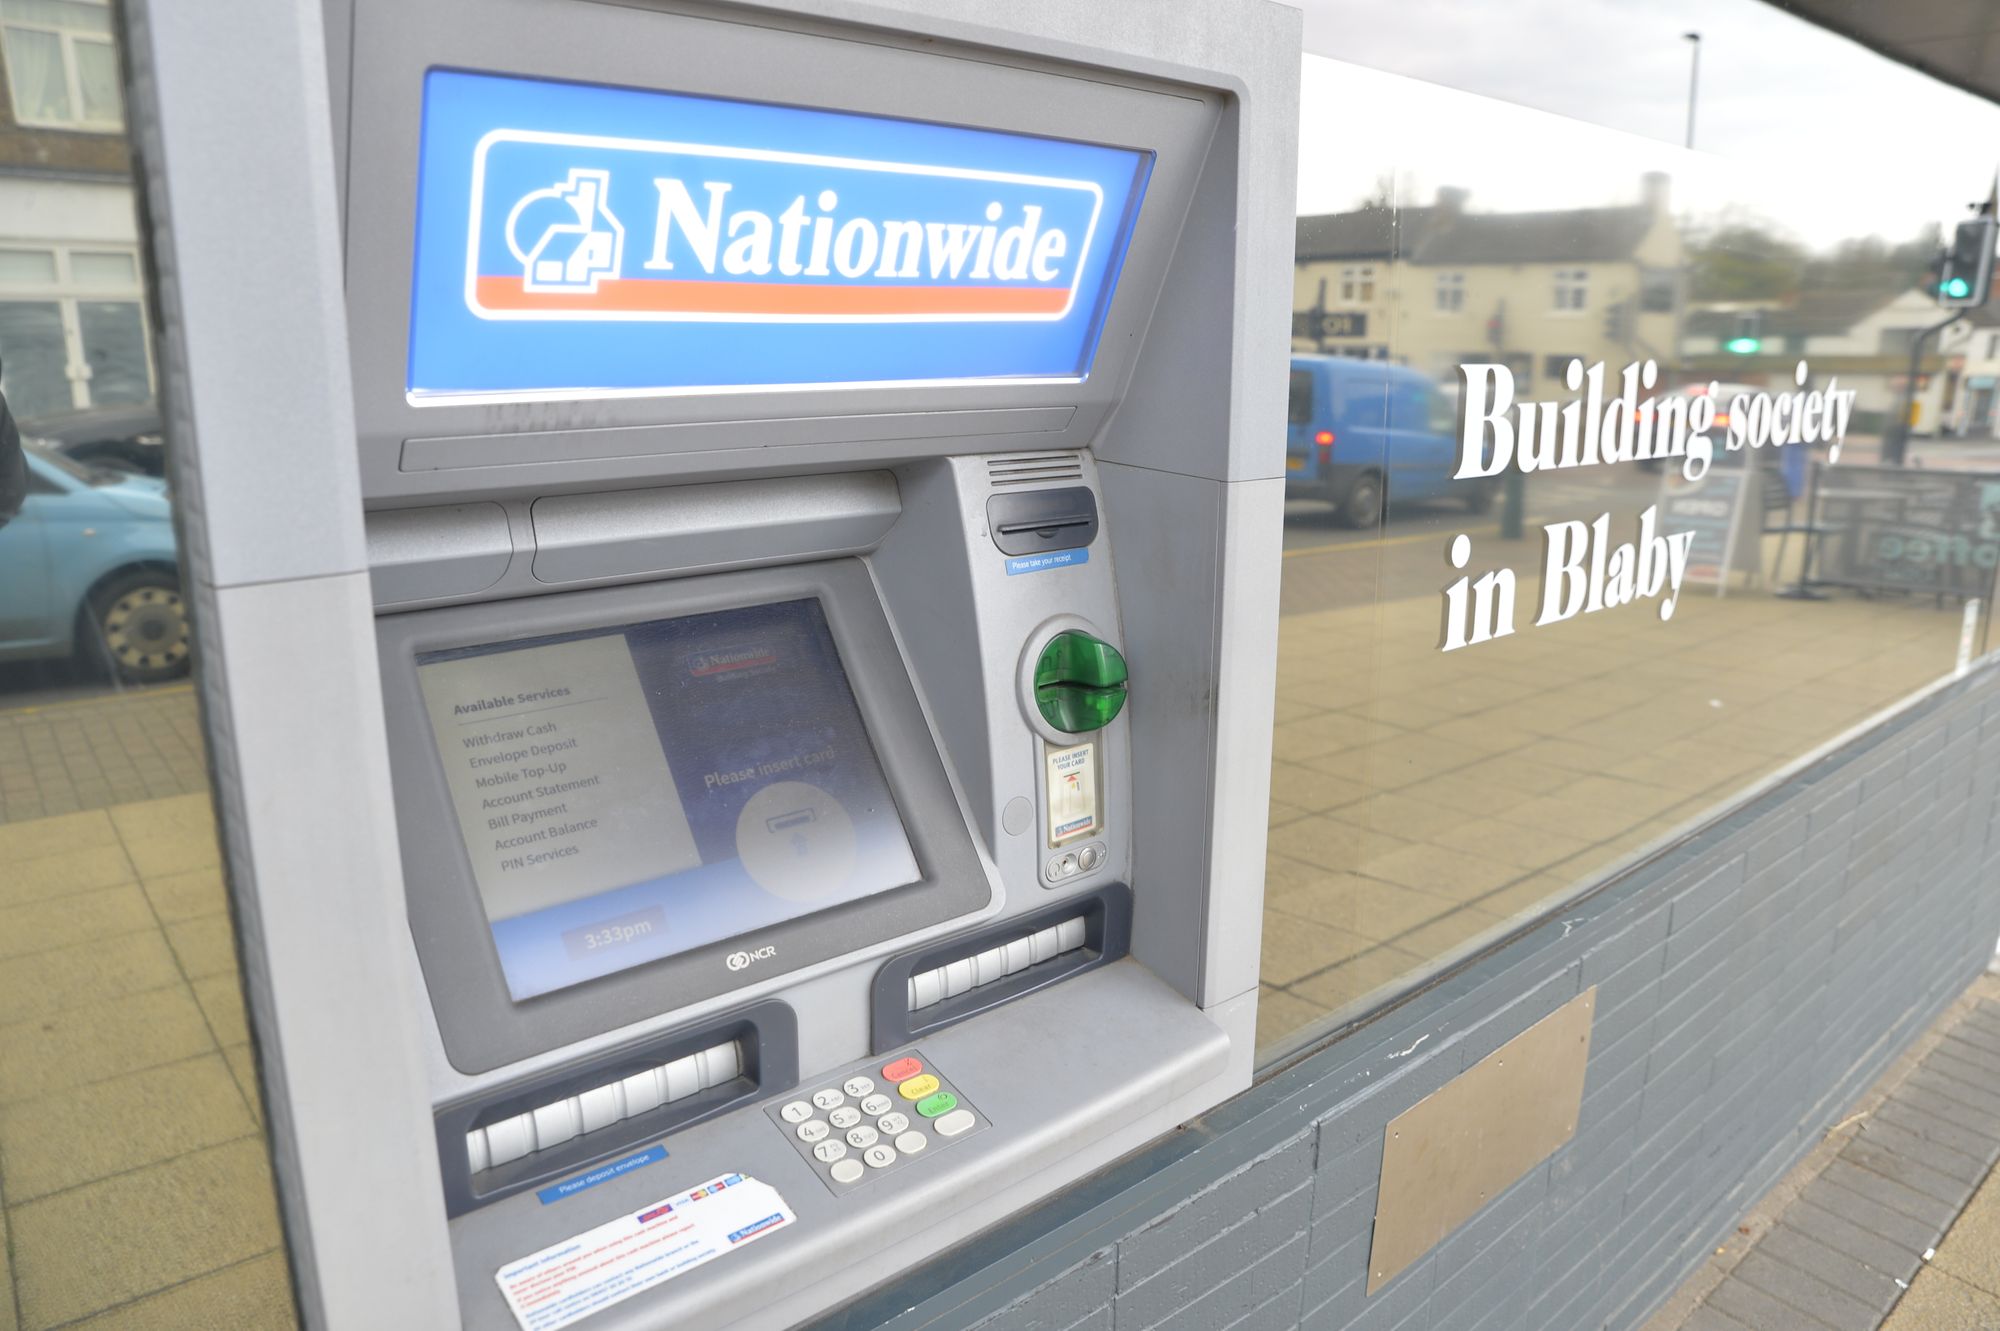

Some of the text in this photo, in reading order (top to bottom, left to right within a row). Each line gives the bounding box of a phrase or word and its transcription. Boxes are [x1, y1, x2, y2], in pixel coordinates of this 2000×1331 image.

[643, 177, 1068, 282] Nationwide
[1452, 358, 1857, 482] Building society
[1012, 554, 1072, 569] Please take your receipt
[1442, 504, 1696, 653] in Blaby
[454, 687, 571, 715] Available Services
[462, 721, 557, 748] Withdraw Cash
[469, 737, 578, 769] Envelope Deposit
[1052, 749, 1089, 765] PLEASE INSERT
[1057, 758, 1085, 771] YOUR CARD
[475, 761, 567, 789] Mobile Top-Up
[704, 744, 835, 789] Please insert card
[482, 775, 601, 810] Account Statement
[488, 803, 568, 830] Bill Payment
[495, 818, 598, 850] Account Balance
[501, 845, 579, 872] PIN Services
[584, 919, 652, 949] 3:33pm
[750, 945, 777, 962] NCR
[847, 1083, 859, 1094] 3
[791, 1107, 802, 1117] 1
[817, 1096, 829, 1106] 2
[866, 1101, 877, 1112] 6
[833, 1113, 845, 1124] 5
[881, 1120, 893, 1130] 9
[804, 1127, 815, 1137] 4
[850, 1132, 863, 1144] 8
[817, 1145, 828, 1158] 7
[873, 1150, 886, 1161] 0
[558, 1154, 651, 1193] Please deposit envelope
[740, 1213, 782, 1237] Nationwide
